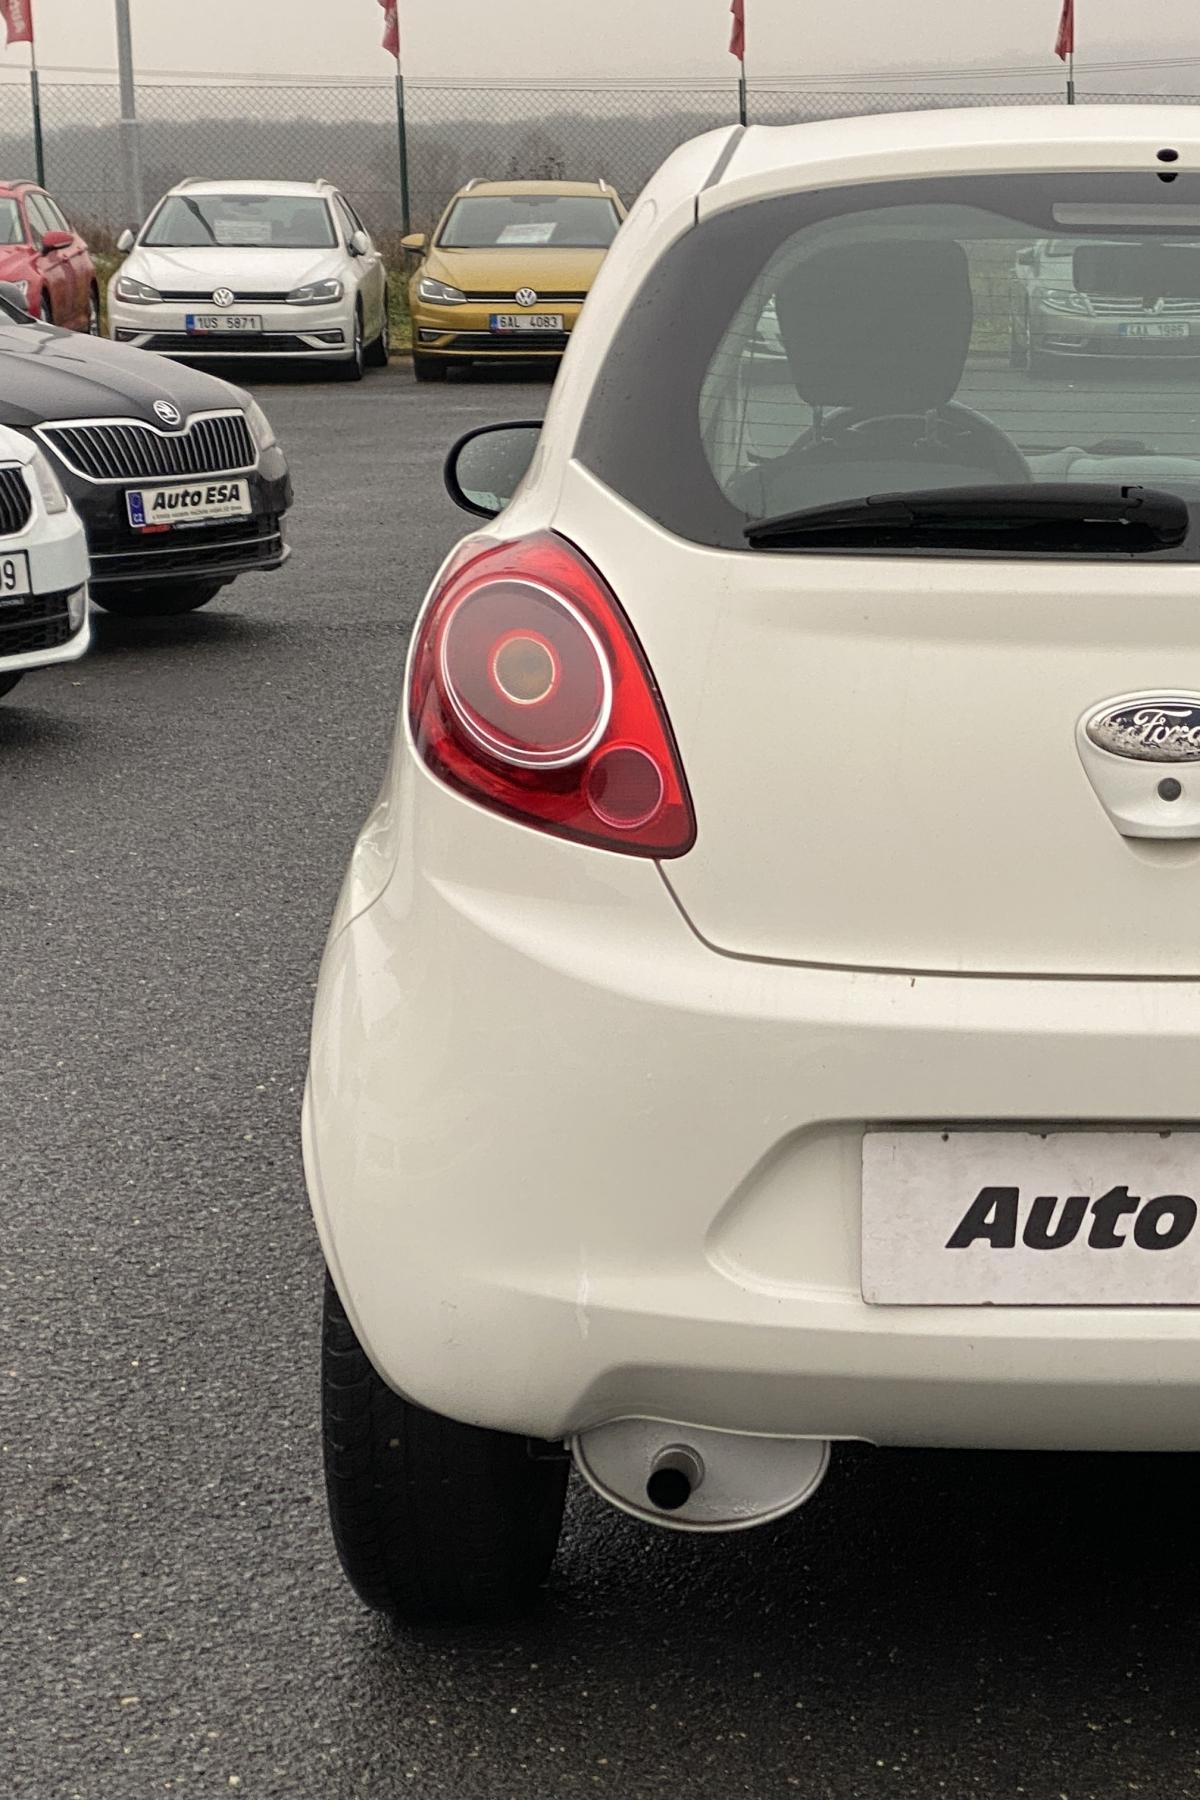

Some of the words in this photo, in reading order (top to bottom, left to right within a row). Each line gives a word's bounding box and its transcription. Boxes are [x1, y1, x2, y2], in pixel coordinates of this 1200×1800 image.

[197, 317, 218, 329] 1US
[226, 317, 256, 329] 5871
[500, 316, 520, 328] 6AL
[152, 490, 202, 510] Auto
[205, 484, 240, 504] ESA
[944, 1186, 1198, 1250] Auto
